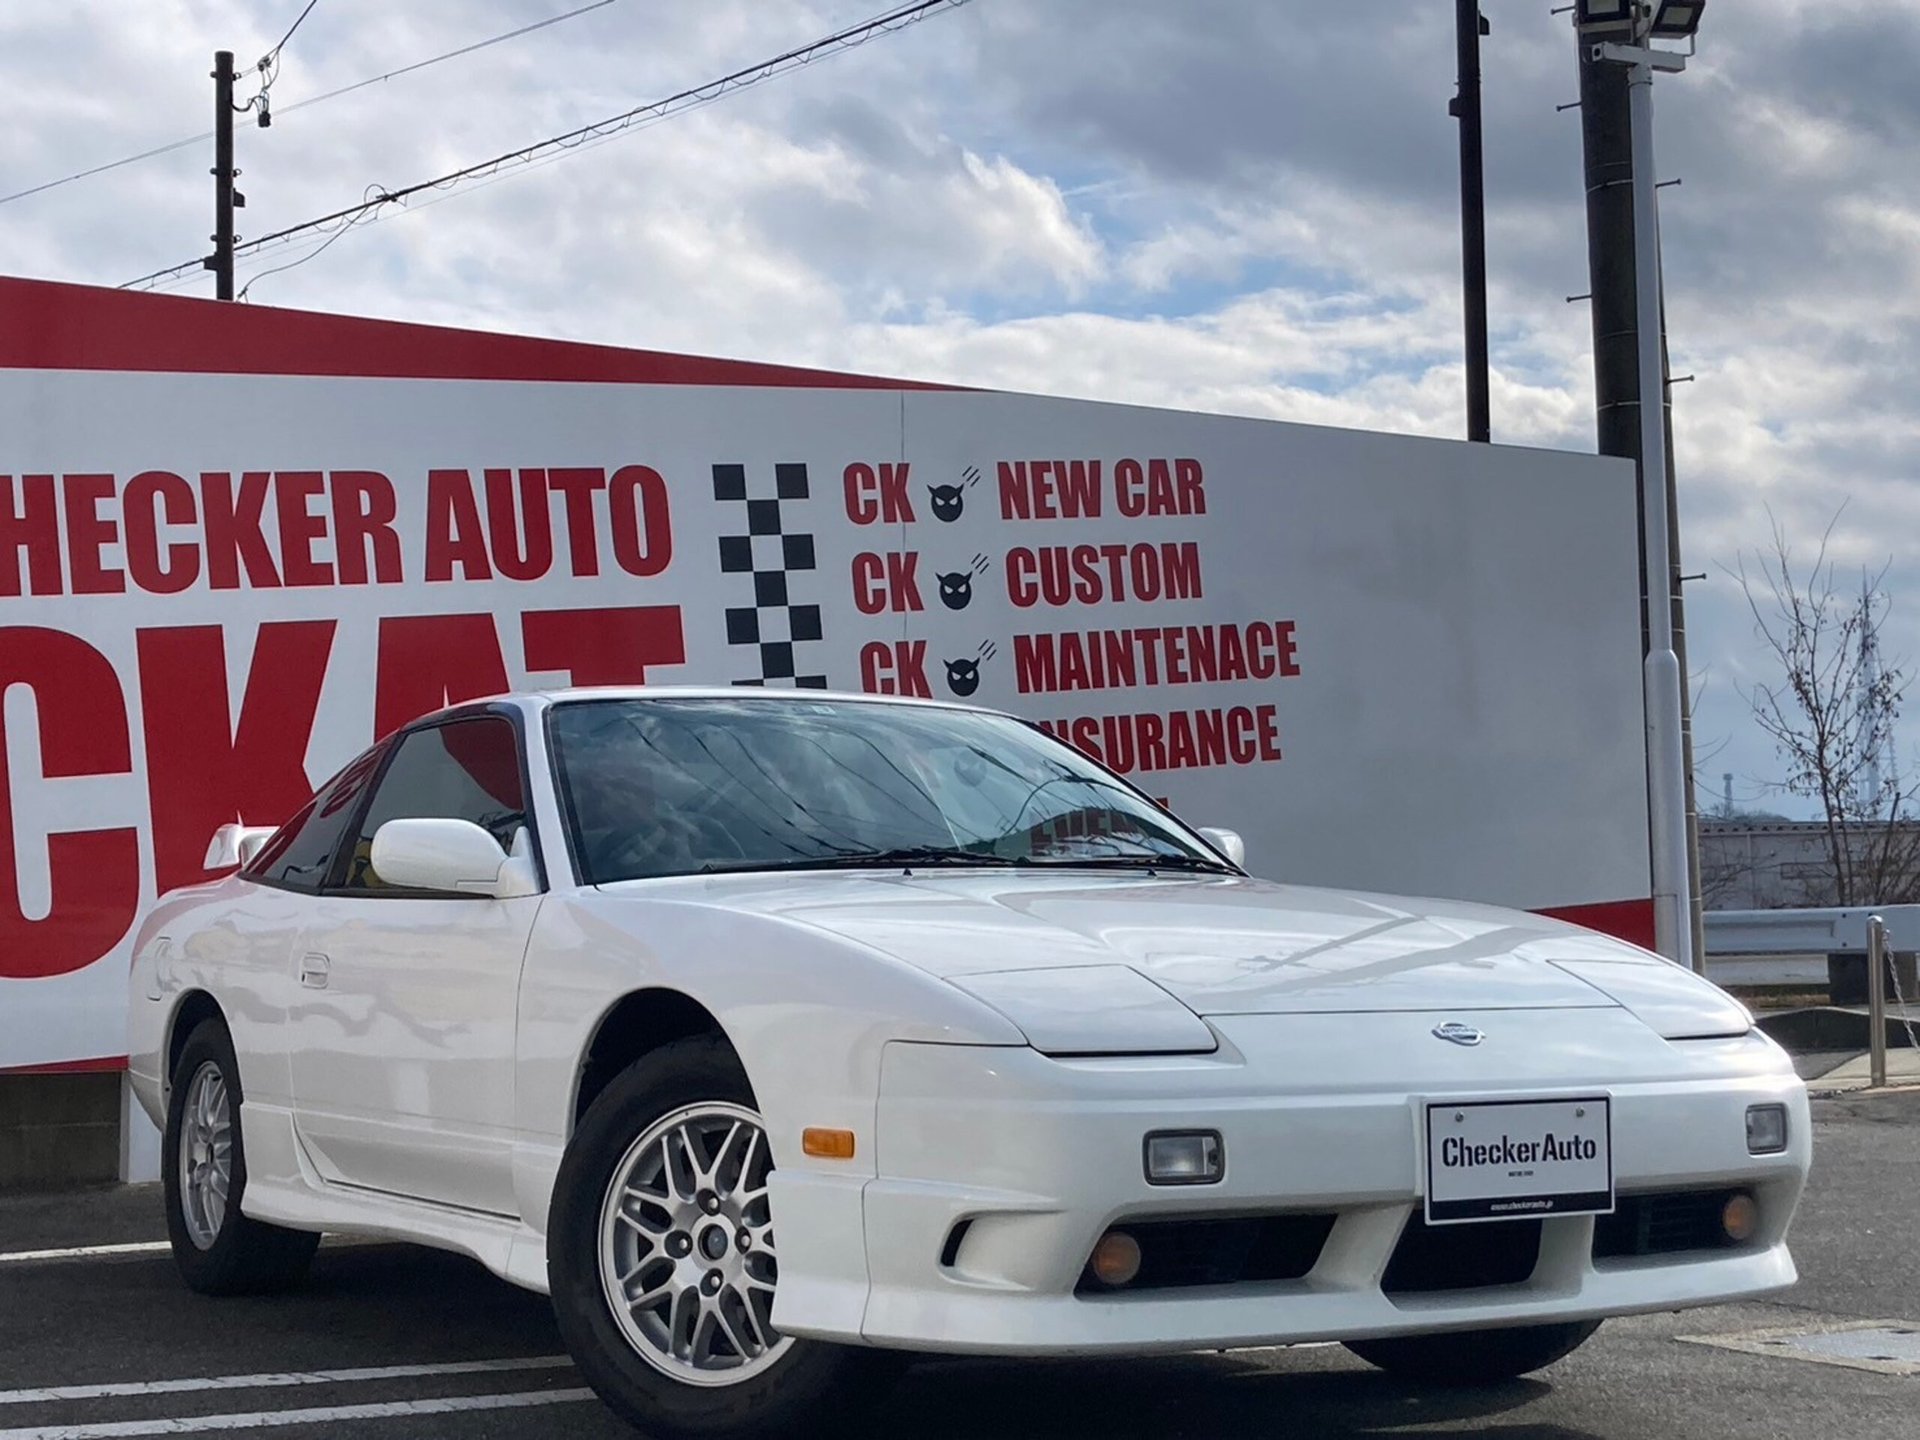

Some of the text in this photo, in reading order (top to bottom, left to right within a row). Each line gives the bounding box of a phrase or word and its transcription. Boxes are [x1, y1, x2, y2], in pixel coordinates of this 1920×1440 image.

[425, 465, 674, 583] AUTO
[843, 458, 1206, 525] CK NEW CAR
[851, 542, 1203, 615] CK CUSTOM
[860, 620, 1301, 699] CK MAINTENACE
[1441, 1133, 1597, 1168] CheckerAuto
